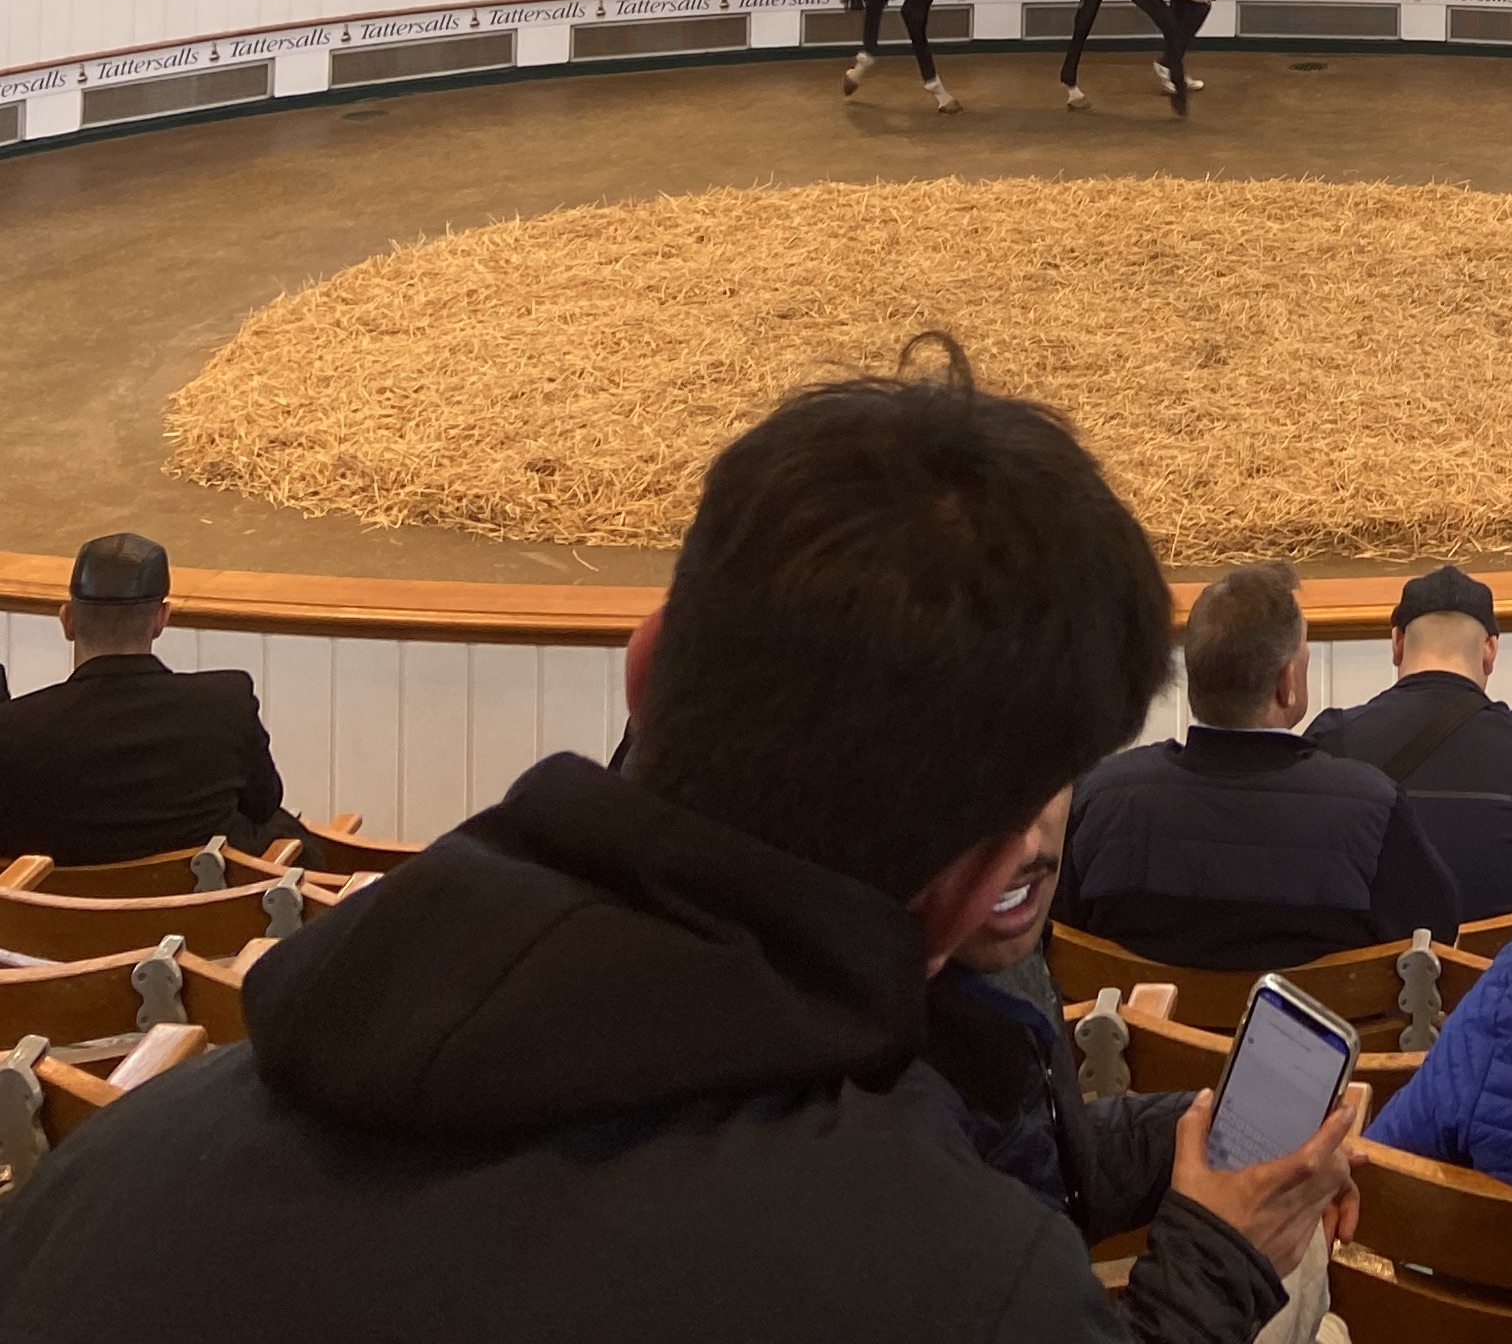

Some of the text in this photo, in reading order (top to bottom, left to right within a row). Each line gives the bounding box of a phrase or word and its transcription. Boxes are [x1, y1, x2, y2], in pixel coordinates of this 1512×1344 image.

[0, 69, 67, 98] ersalls
[96, 47, 199, 80] Tattersalls
[230, 28, 331, 59] Tattersalls
[360, 13, 460, 41] Tattersalls
[489, 2, 586, 27] Tattersalls
